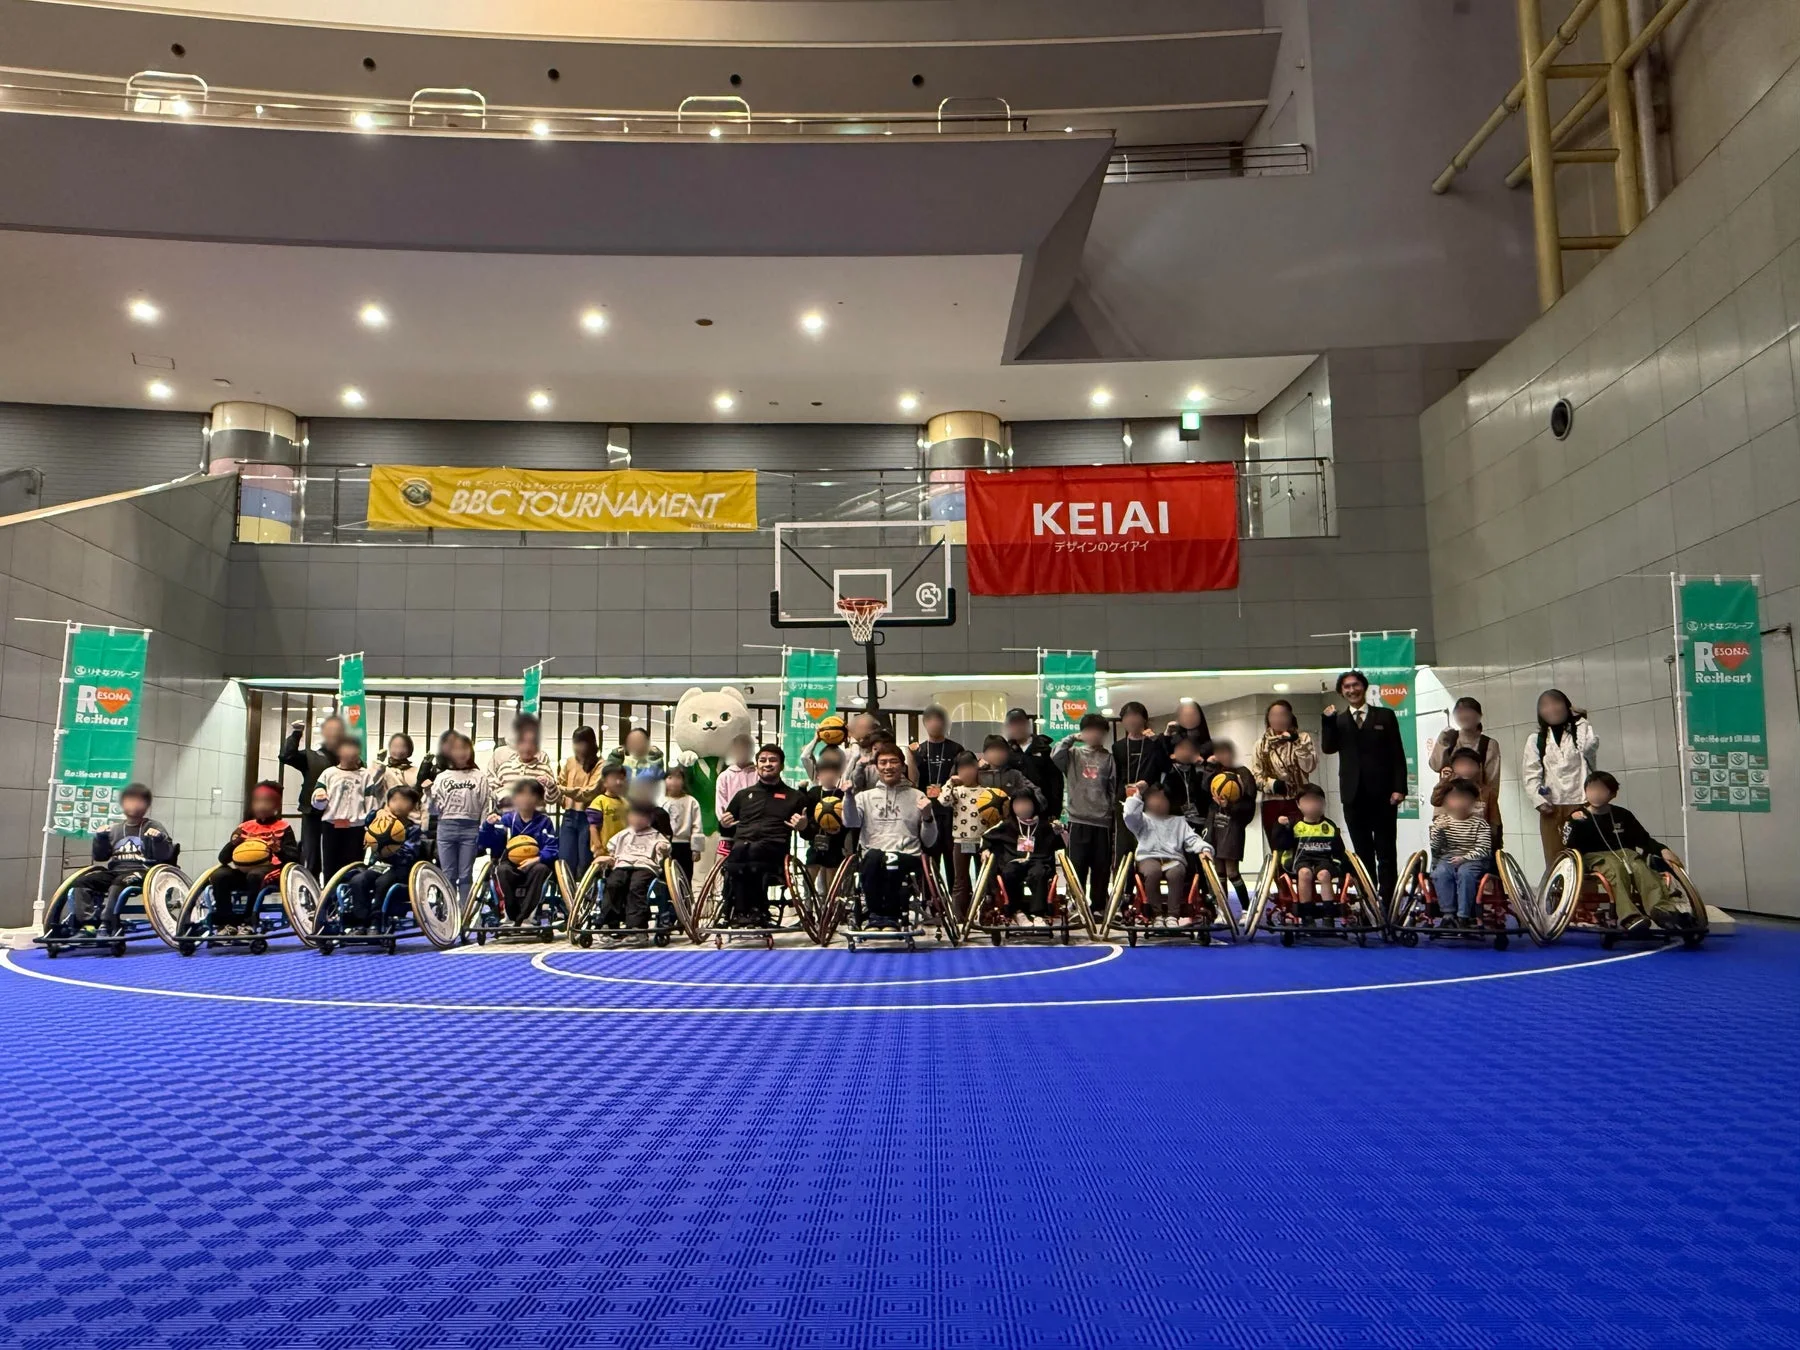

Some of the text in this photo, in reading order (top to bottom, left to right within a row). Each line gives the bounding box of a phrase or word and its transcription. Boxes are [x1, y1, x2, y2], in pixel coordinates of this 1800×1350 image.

[448, 489, 726, 519] BBC TOURNAMENT
[1033, 501, 1170, 536] KEIAI
[1054, 540, 1150, 553] デザインのケイアイ
[1695, 672, 1752, 683] Re:Heart
[75, 713, 129, 726] Re:Heart
[790, 719, 820, 729] Re:Hea
[1049, 721, 1080, 730] Re:Hea
